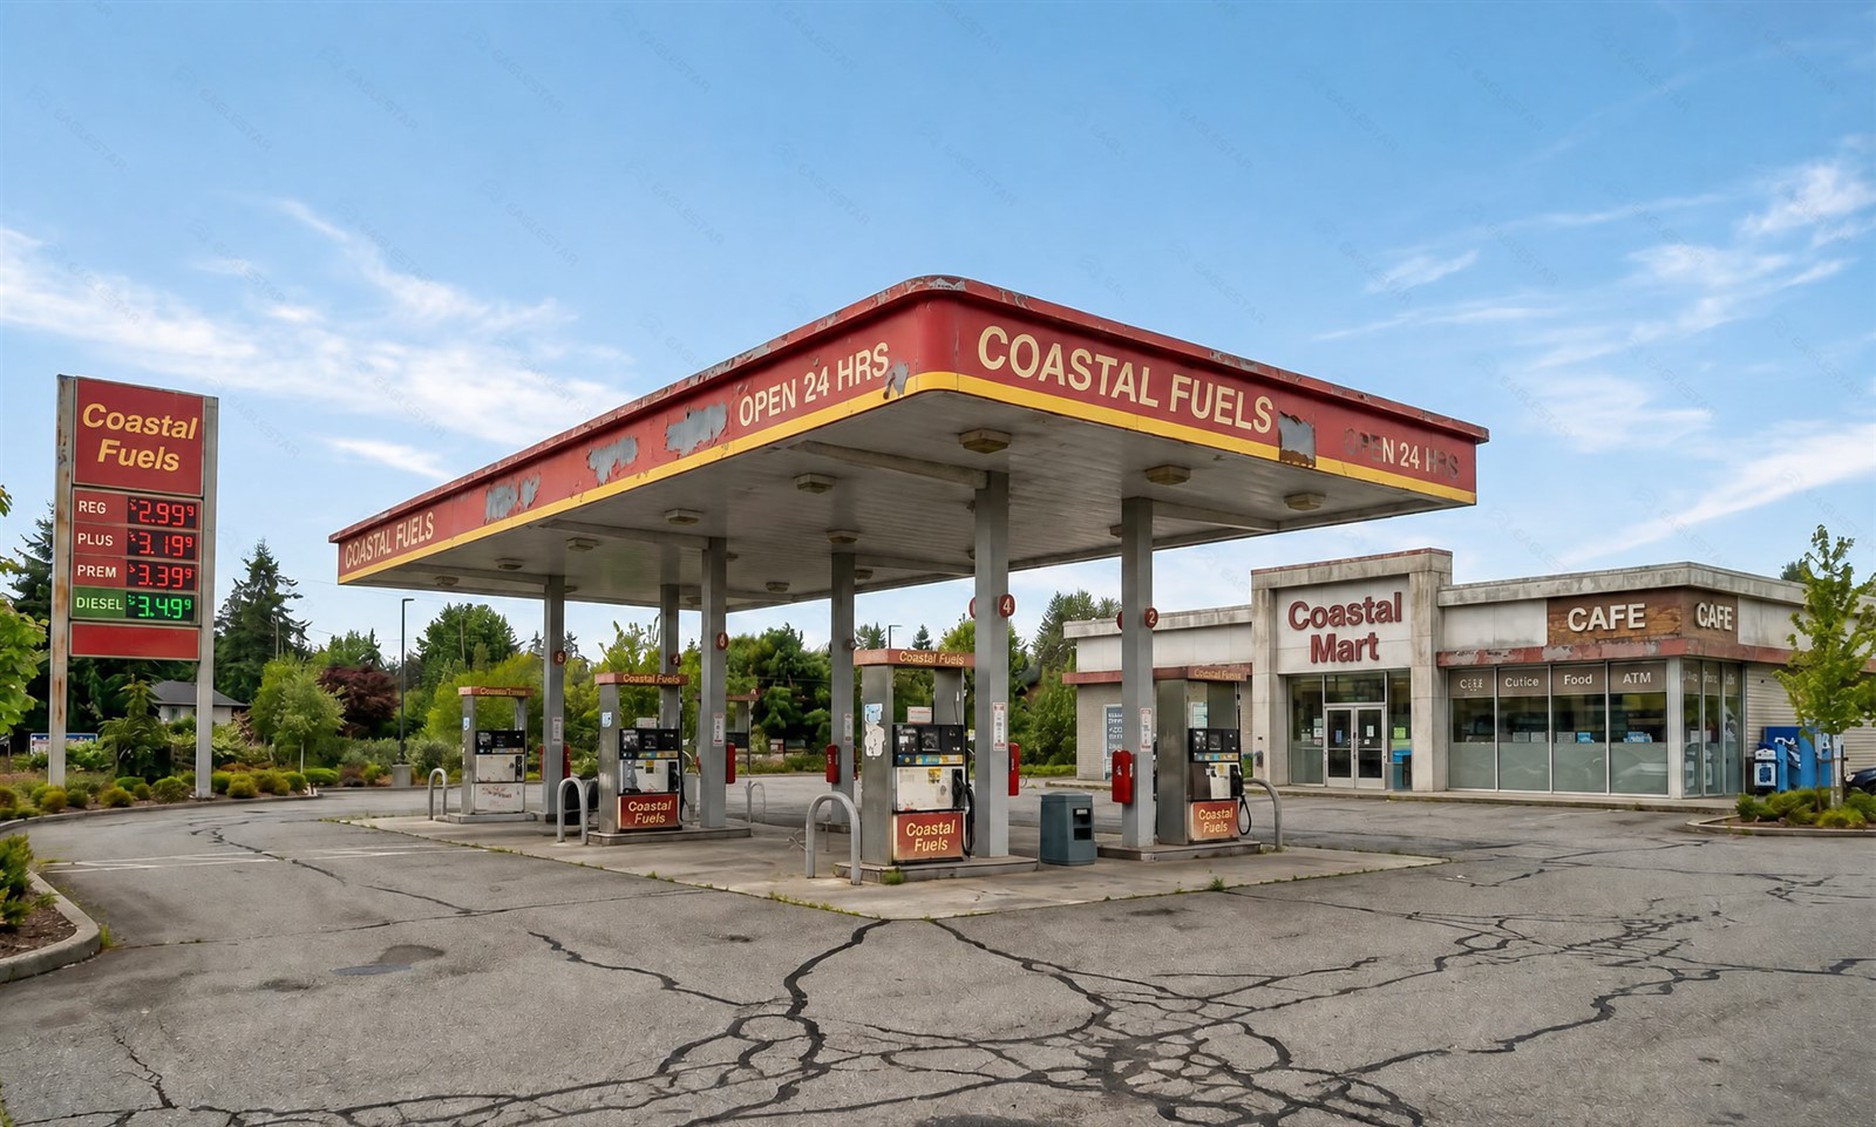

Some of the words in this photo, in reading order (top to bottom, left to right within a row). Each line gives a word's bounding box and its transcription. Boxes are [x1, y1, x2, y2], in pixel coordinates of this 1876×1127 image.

[739, 378, 797, 427] OPEN
[804, 365, 829, 404] 24
[838, 341, 890, 391] HRS
[977, 325, 1159, 408] COASTAL
[1169, 373, 1274, 434] FUELS
[82, 403, 198, 439] Coastal
[98, 439, 180, 471] Fuels
[1400, 442, 1420, 469] 24
[78, 500, 106, 514] REG
[77, 533, 113, 546] PLUS
[345, 530, 392, 568] COASTAL
[396, 511, 434, 549] FUELS
[77, 565, 116, 578] PREM
[76, 597, 123, 610] DIESEL
[1003, 598, 1011, 613] 4
[1288, 591, 1403, 631] Coastal
[1149, 611, 1156, 623] 2
[1567, 602, 1646, 633] CAFE
[1695, 601, 1733, 632] CAFE
[1310, 632, 1379, 663] Mart
[899, 650, 937, 664] Coastal
[939, 653, 965, 665] Fuels
[623, 673, 656, 683] Coastal
[656, 674, 680, 684] Fuels
[1564, 674, 1592, 685] Food
[1622, 672, 1652, 684] ATM
[628, 800, 672, 812] Coastal
[1199, 807, 1233, 820] Coastal
[634, 812, 666, 824] Fuels
[906, 820, 955, 836] Coastal
[1203, 821, 1228, 833] Fuels
[914, 837, 948, 852] Fuels
